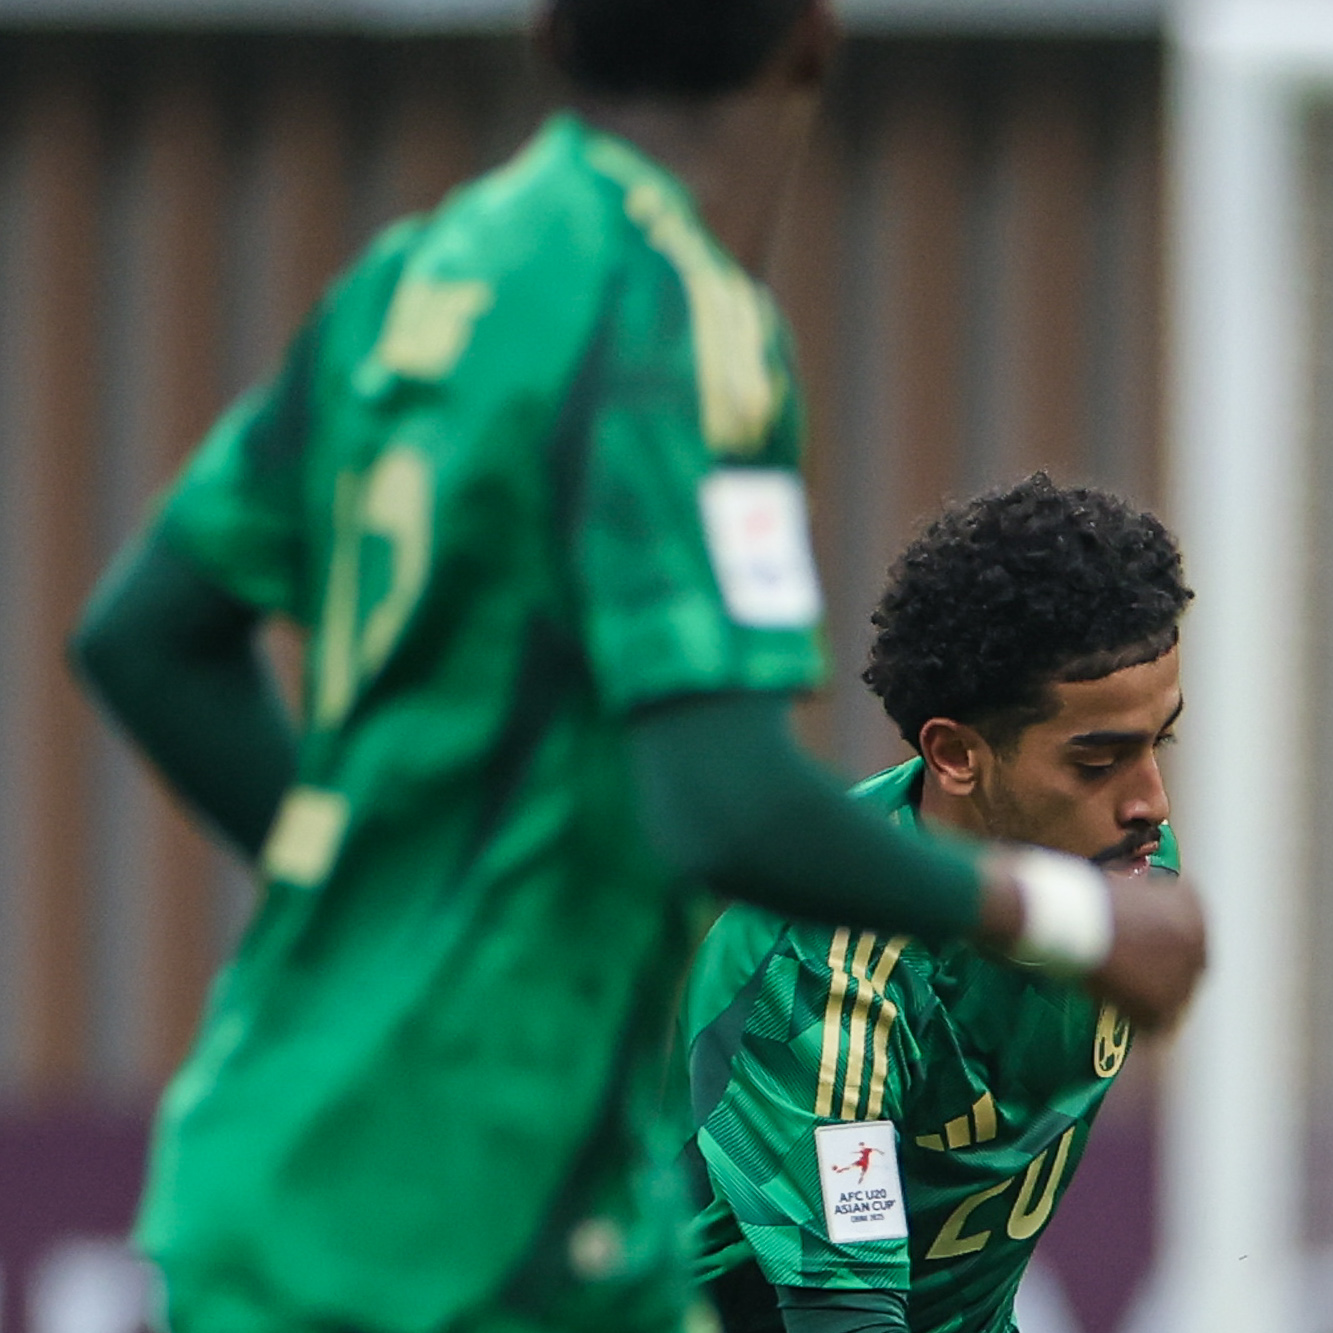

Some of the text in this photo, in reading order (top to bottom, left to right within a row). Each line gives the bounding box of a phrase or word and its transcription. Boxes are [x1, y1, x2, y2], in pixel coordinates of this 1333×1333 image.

[840, 1188, 888, 1203] AFC U20
[834, 1200, 897, 1216] ASIAN CUP
